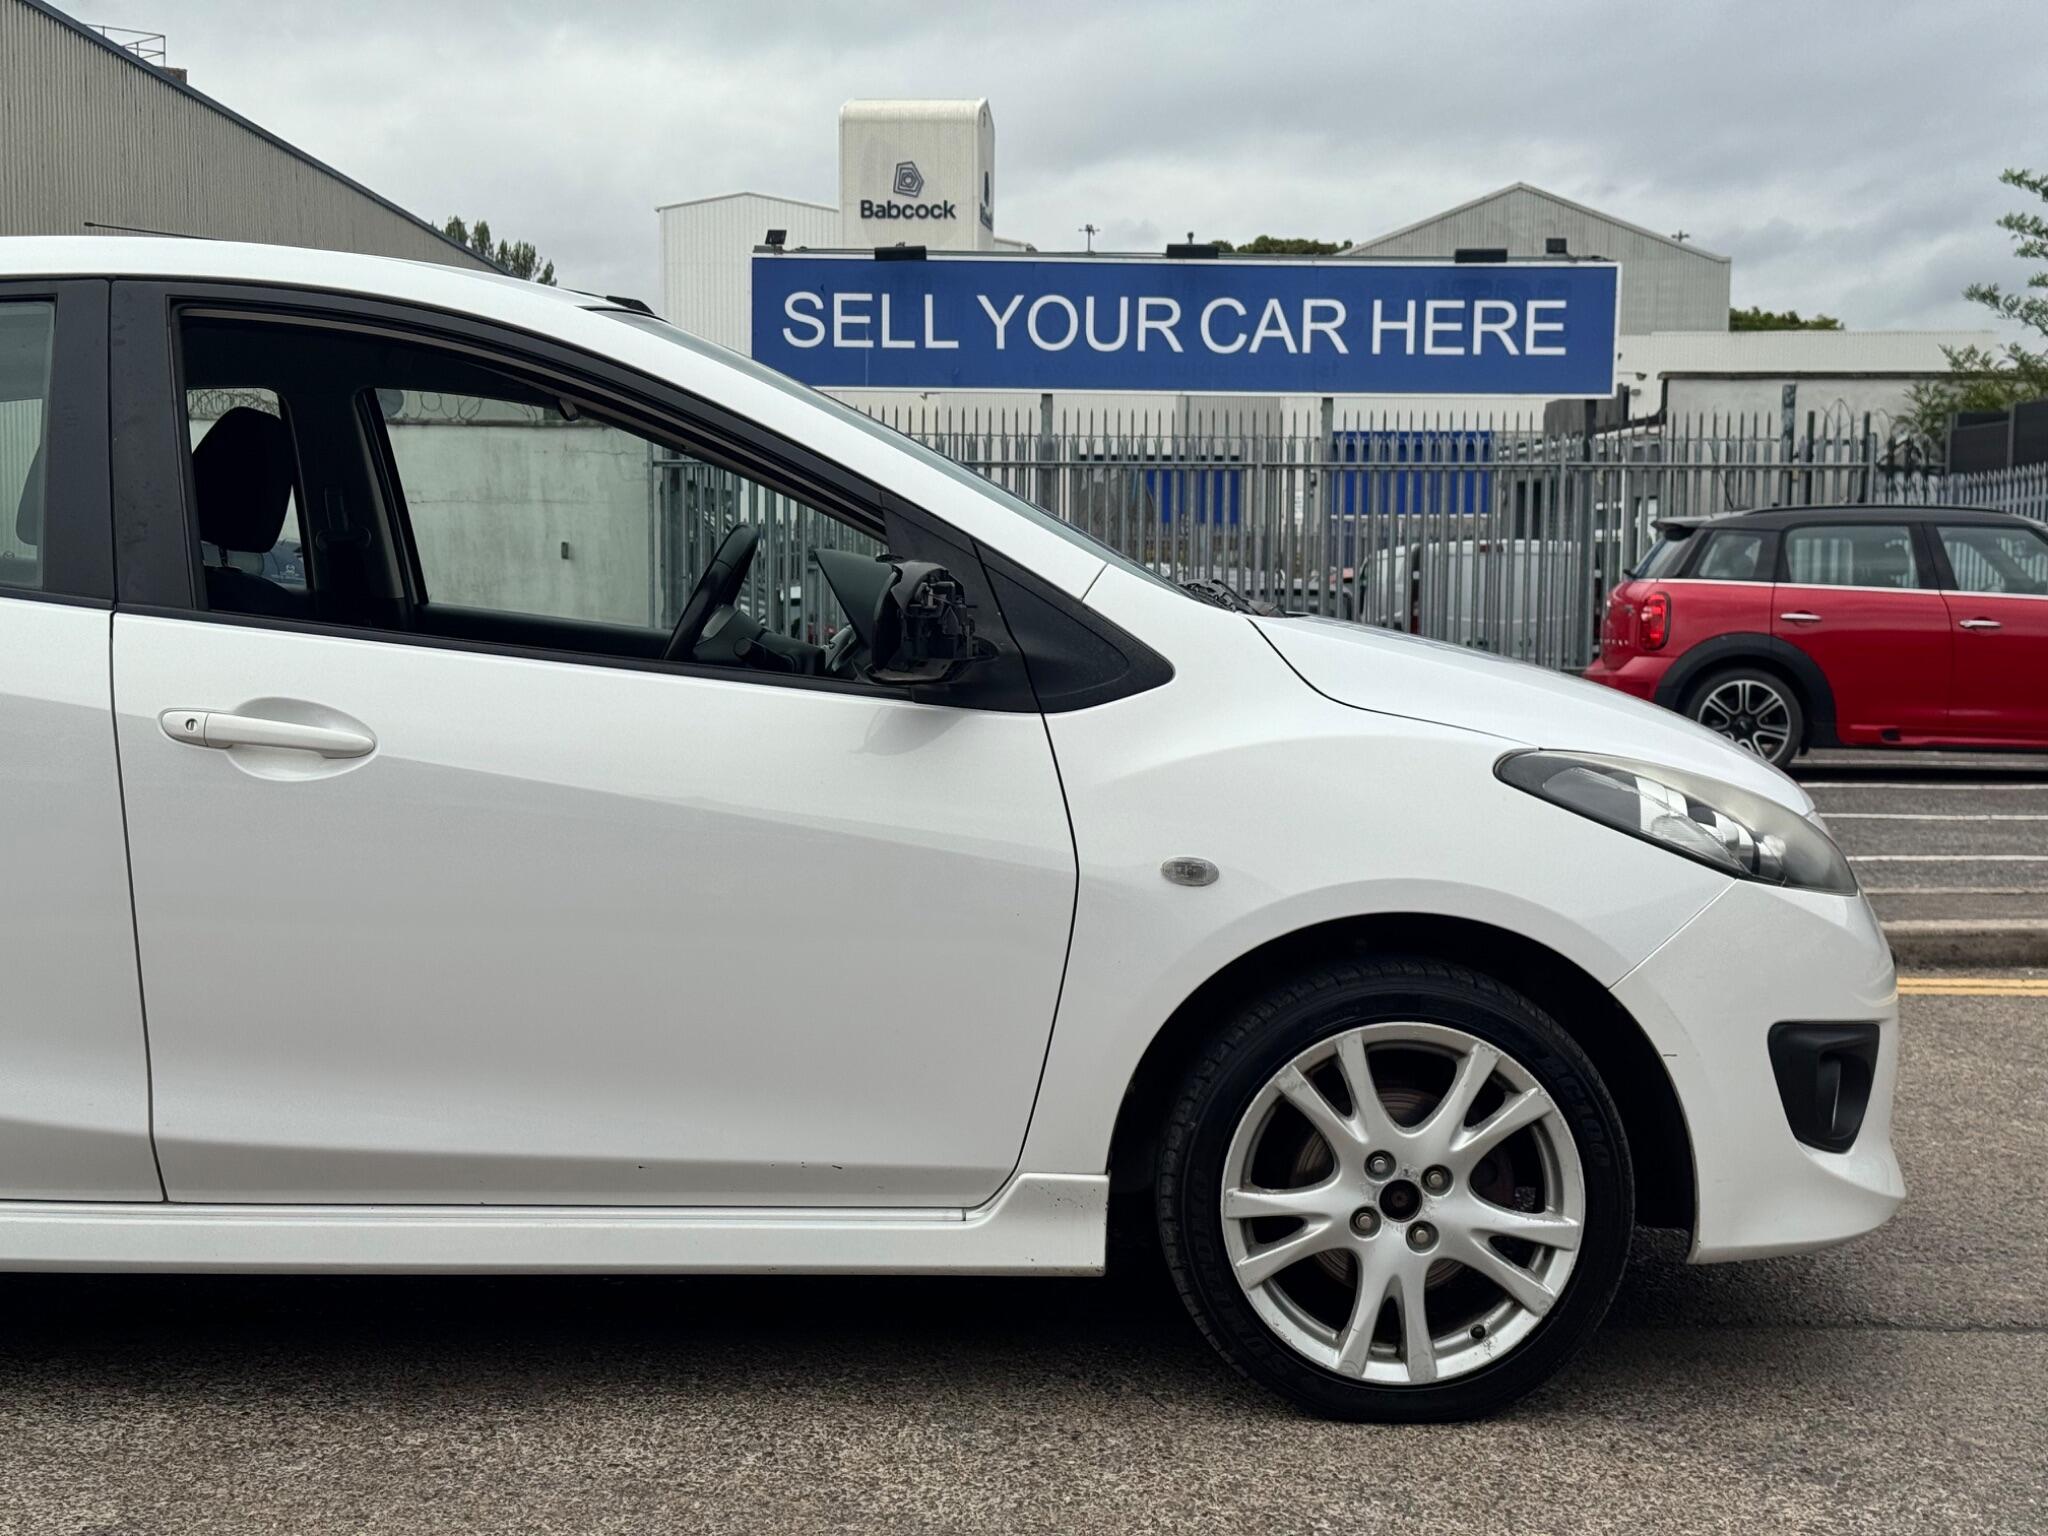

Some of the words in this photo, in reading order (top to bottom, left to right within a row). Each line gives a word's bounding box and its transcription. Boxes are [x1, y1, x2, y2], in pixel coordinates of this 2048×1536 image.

[860, 200, 956, 220] Babcock
[782, 291, 959, 349] SELL
[976, 294, 1184, 353] YOUR
[1200, 297, 1349, 354] CAR
[1372, 299, 1567, 356] HERE
